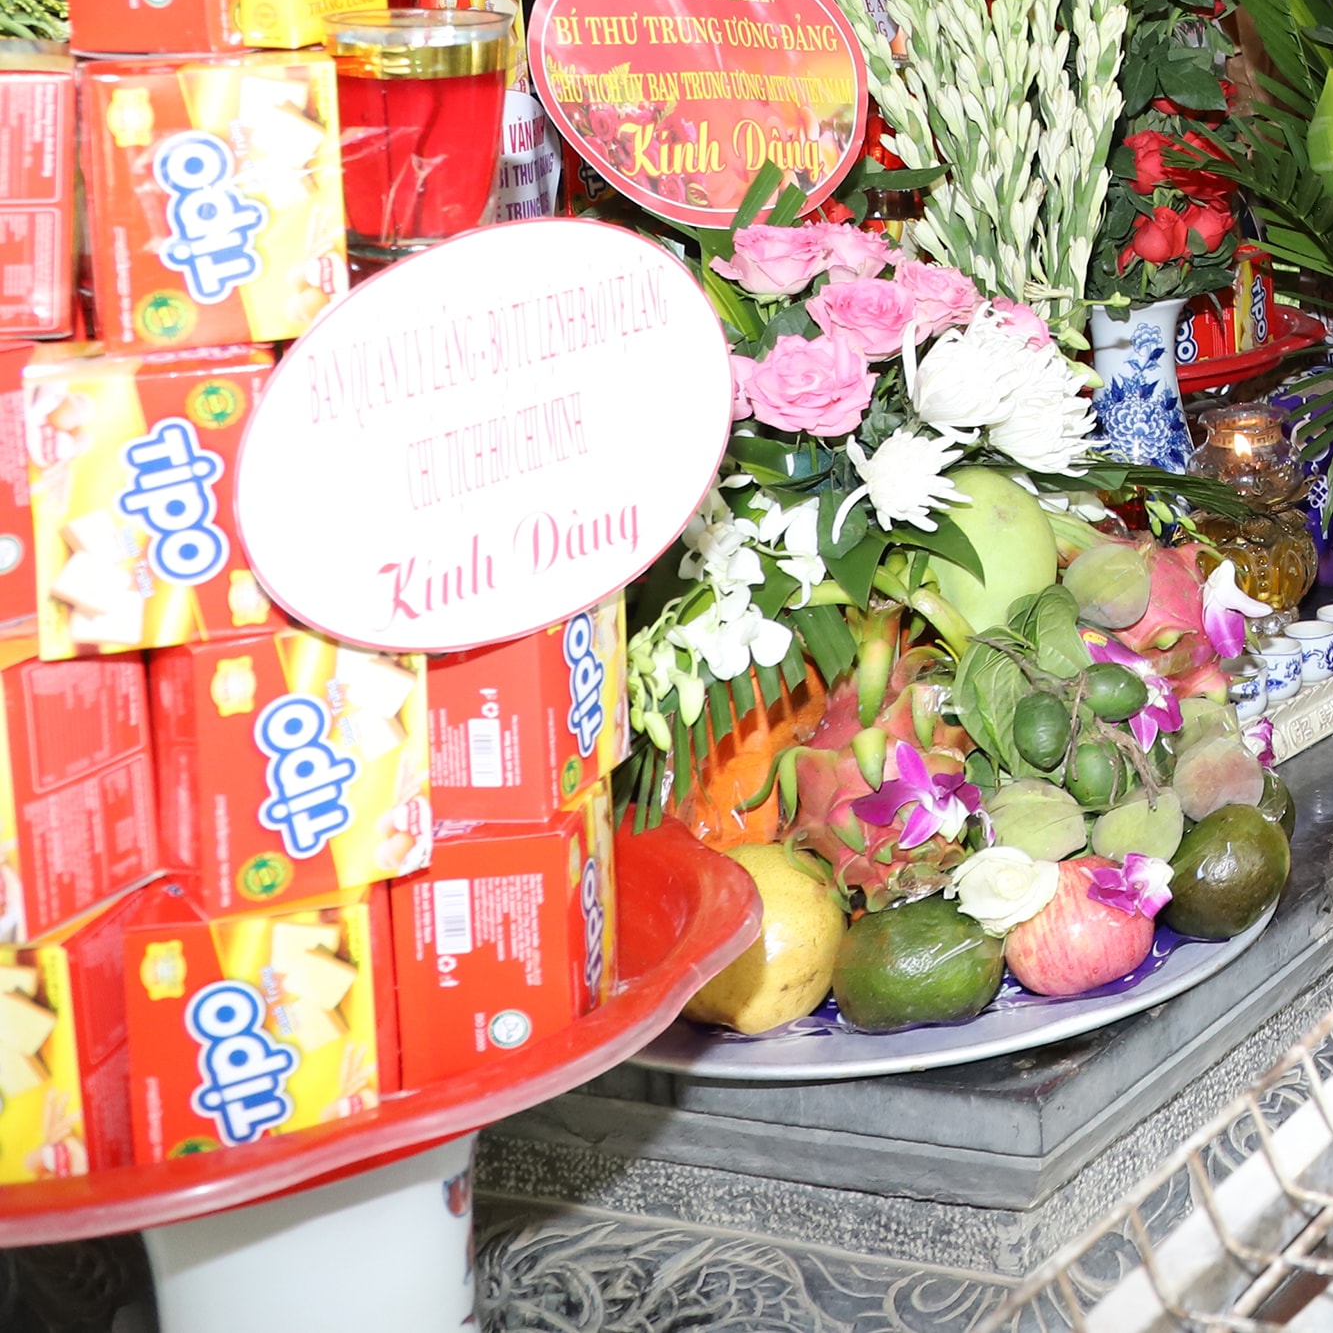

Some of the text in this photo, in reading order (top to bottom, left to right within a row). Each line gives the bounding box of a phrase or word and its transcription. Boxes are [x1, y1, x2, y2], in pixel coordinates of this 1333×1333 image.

[554, 7, 582, 45] BÍ
[585, 12, 638, 45] THƯ
[644, 16, 723, 45] TRUNG
[723, 13, 778, 50] ƯƠNG
[779, 13, 838, 52] ĐẢNG
[646, 72, 680, 102] BAN
[681, 71, 731, 100] TRUNG
[729, 69, 766, 101] ƯƠNG
[764, 74, 801, 108] MTTQ
[509, 115, 532, 154] VĂN
[618, 120, 726, 177] Kính
[733, 119, 824, 182] Dâng
[371, 534, 497, 632] Kính
